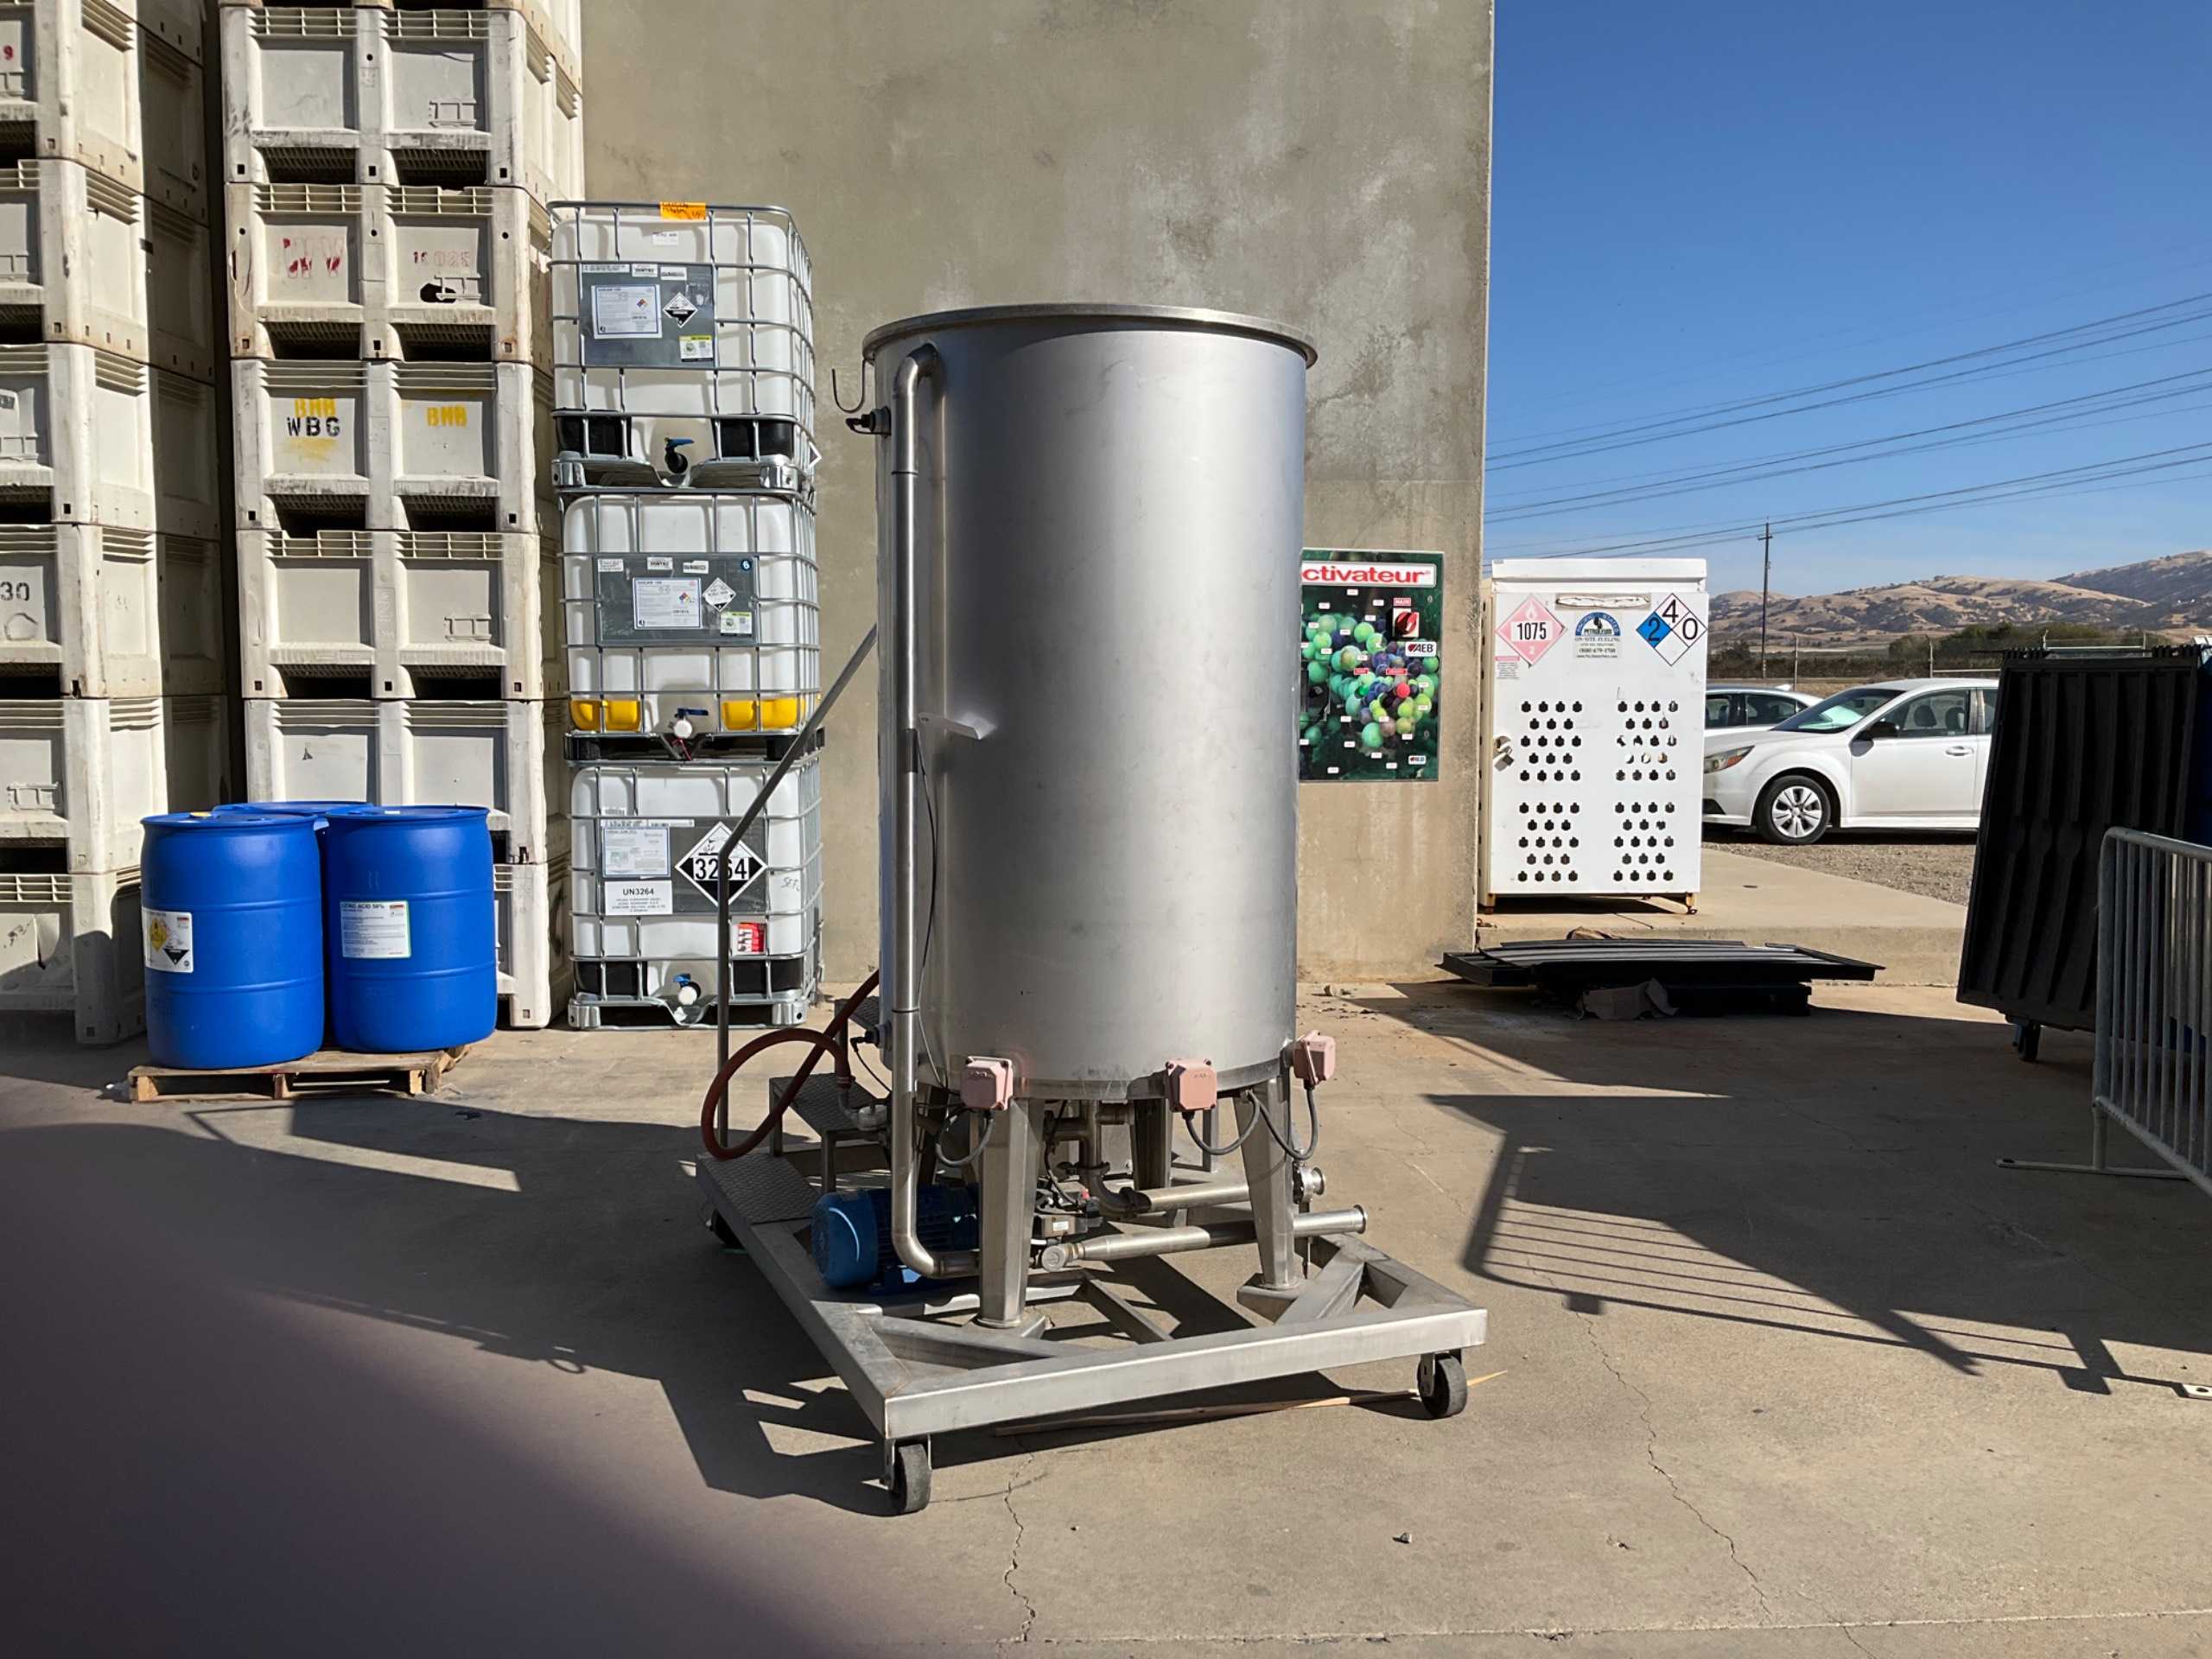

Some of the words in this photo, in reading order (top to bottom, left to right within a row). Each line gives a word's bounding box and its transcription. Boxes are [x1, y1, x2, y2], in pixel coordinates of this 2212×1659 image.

[1662, 599, 1679, 623] 4
[1516, 621, 1547, 640] 1075
[1648, 617, 1660, 641] 2
[1682, 618, 1698, 640] 0
[1414, 643, 1433, 652] AEB
[622, 887, 654, 896] UN3264
